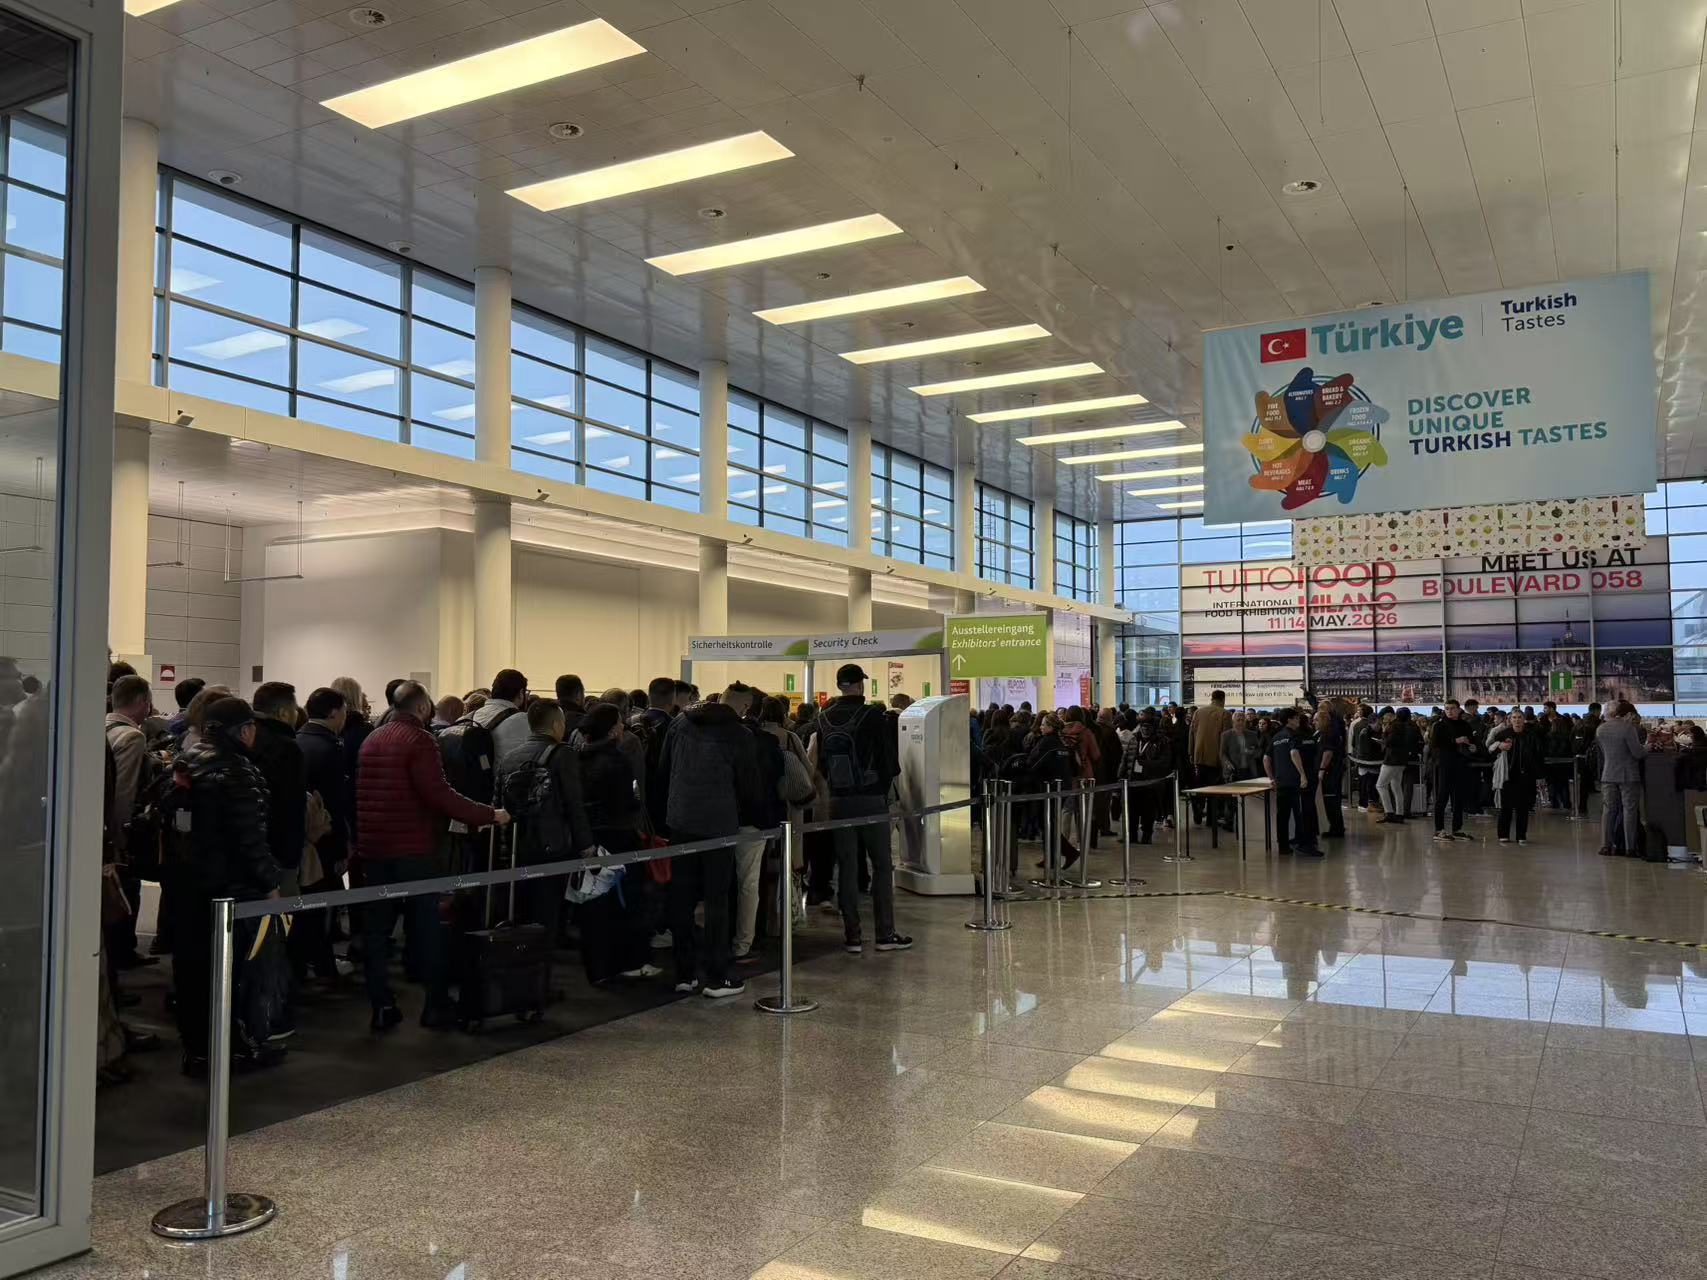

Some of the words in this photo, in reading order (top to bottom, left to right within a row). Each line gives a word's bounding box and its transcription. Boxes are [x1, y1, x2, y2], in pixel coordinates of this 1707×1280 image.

[1501, 293, 1577, 315] Turkish
[1501, 313, 1566, 332] Tastes
[1311, 314, 1464, 355] Türkiye
[1408, 387, 1531, 415] DISCOVER
[1408, 411, 1504, 436] UNIQUE
[1409, 430, 1511, 455] TURKISH
[1518, 421, 1608, 445] TASTES
[1481, 552, 1553, 573] MEET
[1562, 549, 1597, 568] US
[1606, 547, 1641, 566] AT
[1422, 573, 1581, 596] BOULEVARD
[1590, 570, 1642, 590] 058
[1205, 609, 1233, 618] FOOD
[1236, 607, 1295, 617] EXHIBITION
[1213, 599, 1293, 609] INTERNATIONAL
[1298, 592, 1397, 614] MILANO
[952, 624, 1034, 636] Ausstellereingang
[691, 639, 773, 649] Sicherheitskontrolle
[813, 637, 849, 648] Security
[852, 635, 879, 646] Check
[1000, 638, 1042, 647] entrance
